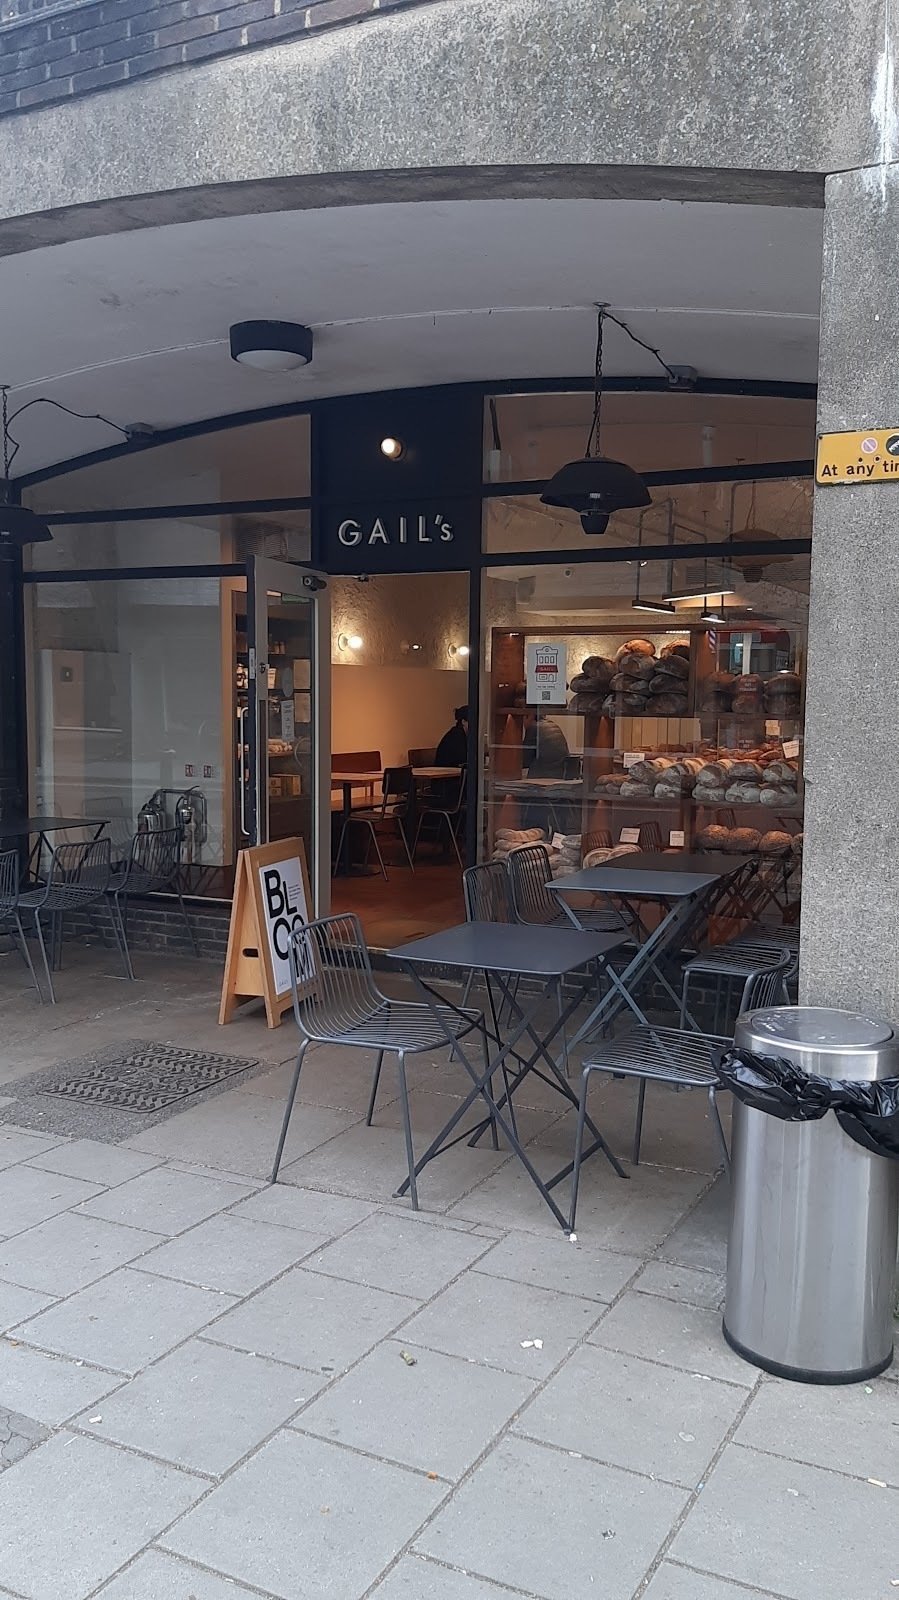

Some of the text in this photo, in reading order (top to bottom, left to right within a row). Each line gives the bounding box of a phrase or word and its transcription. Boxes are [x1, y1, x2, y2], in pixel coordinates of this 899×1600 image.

[821, 464, 838, 477] At
[846, 464, 875, 477] any
[338, 514, 454, 546] GAIL's
